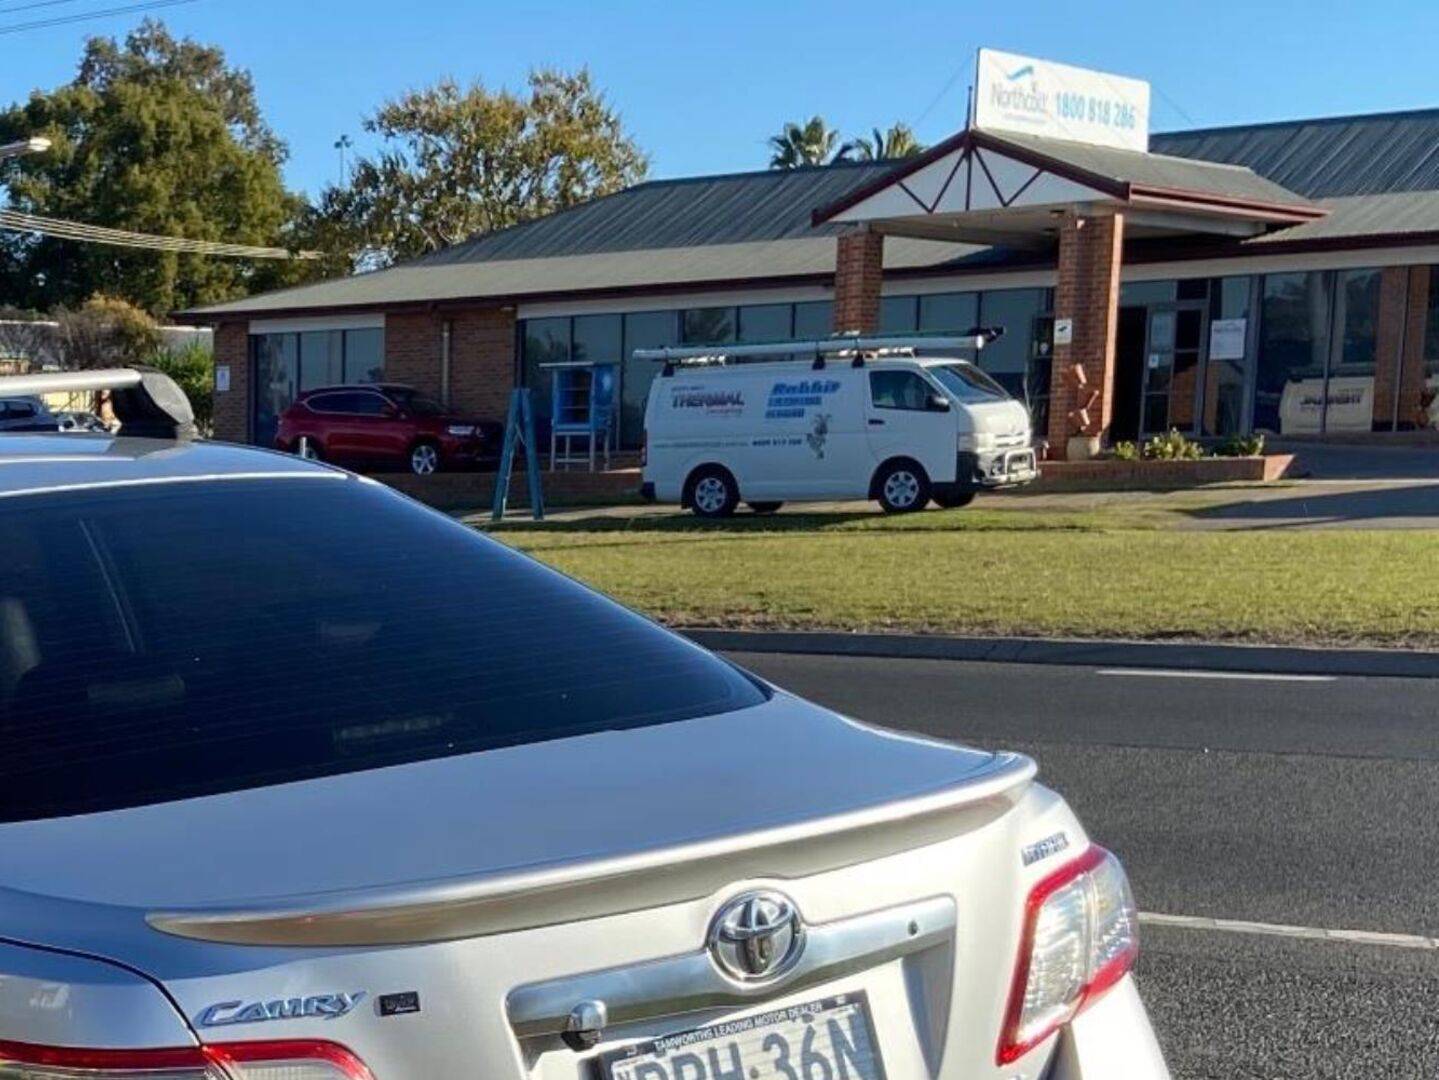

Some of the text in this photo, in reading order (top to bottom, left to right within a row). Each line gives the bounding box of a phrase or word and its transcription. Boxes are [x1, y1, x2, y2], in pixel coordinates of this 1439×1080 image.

[1056, 92, 1085, 120] 1800
[192, 990, 368, 1029] CAMRY
[713, 1018, 754, 1038] LEADING
[753, 1010, 788, 1031] MOTOR
[788, 1001, 824, 1024] DEALER
